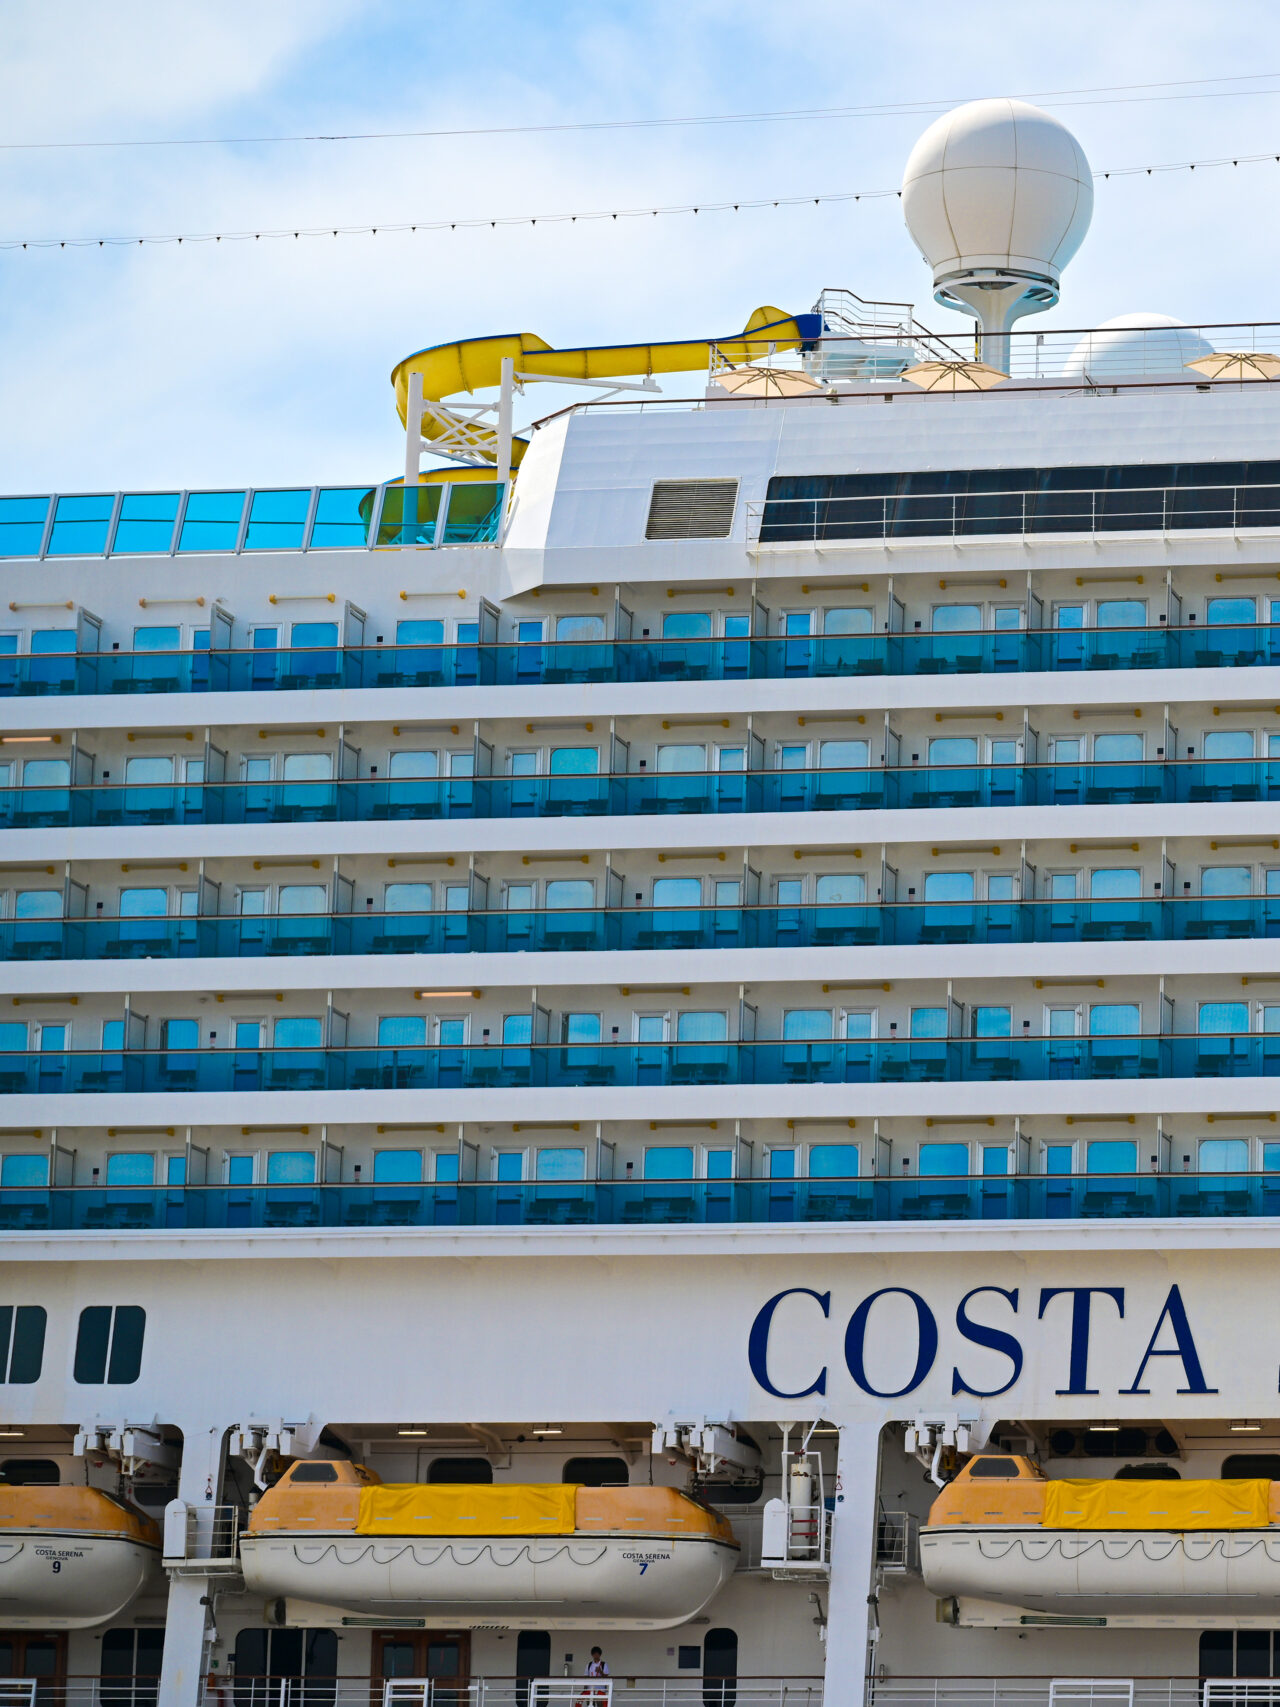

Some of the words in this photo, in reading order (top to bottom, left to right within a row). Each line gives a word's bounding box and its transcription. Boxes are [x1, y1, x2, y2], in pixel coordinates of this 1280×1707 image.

[747, 1285, 1219, 1399] COSTA
[52, 1560, 62, 1573] 9
[639, 1563, 649, 1575] 7
